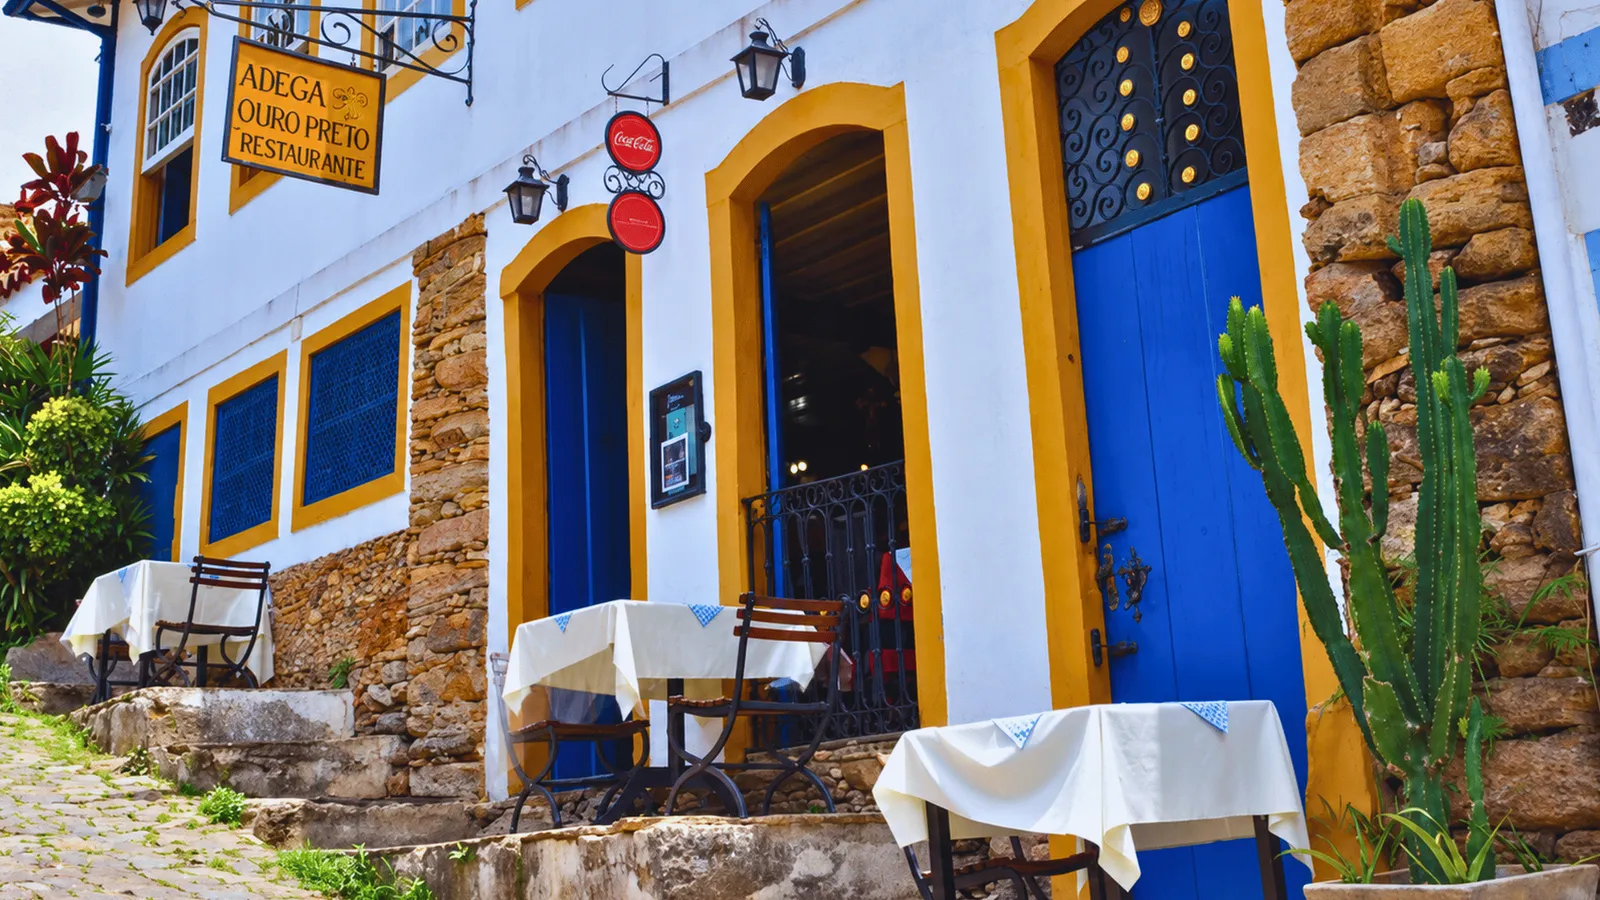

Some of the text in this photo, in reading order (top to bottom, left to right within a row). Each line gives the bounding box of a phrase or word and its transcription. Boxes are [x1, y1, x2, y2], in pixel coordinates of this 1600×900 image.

[239, 63, 326, 108] ADEGA
[237, 98, 370, 151] OURO PRETO
[240, 132, 365, 180] RESTAURANTE
